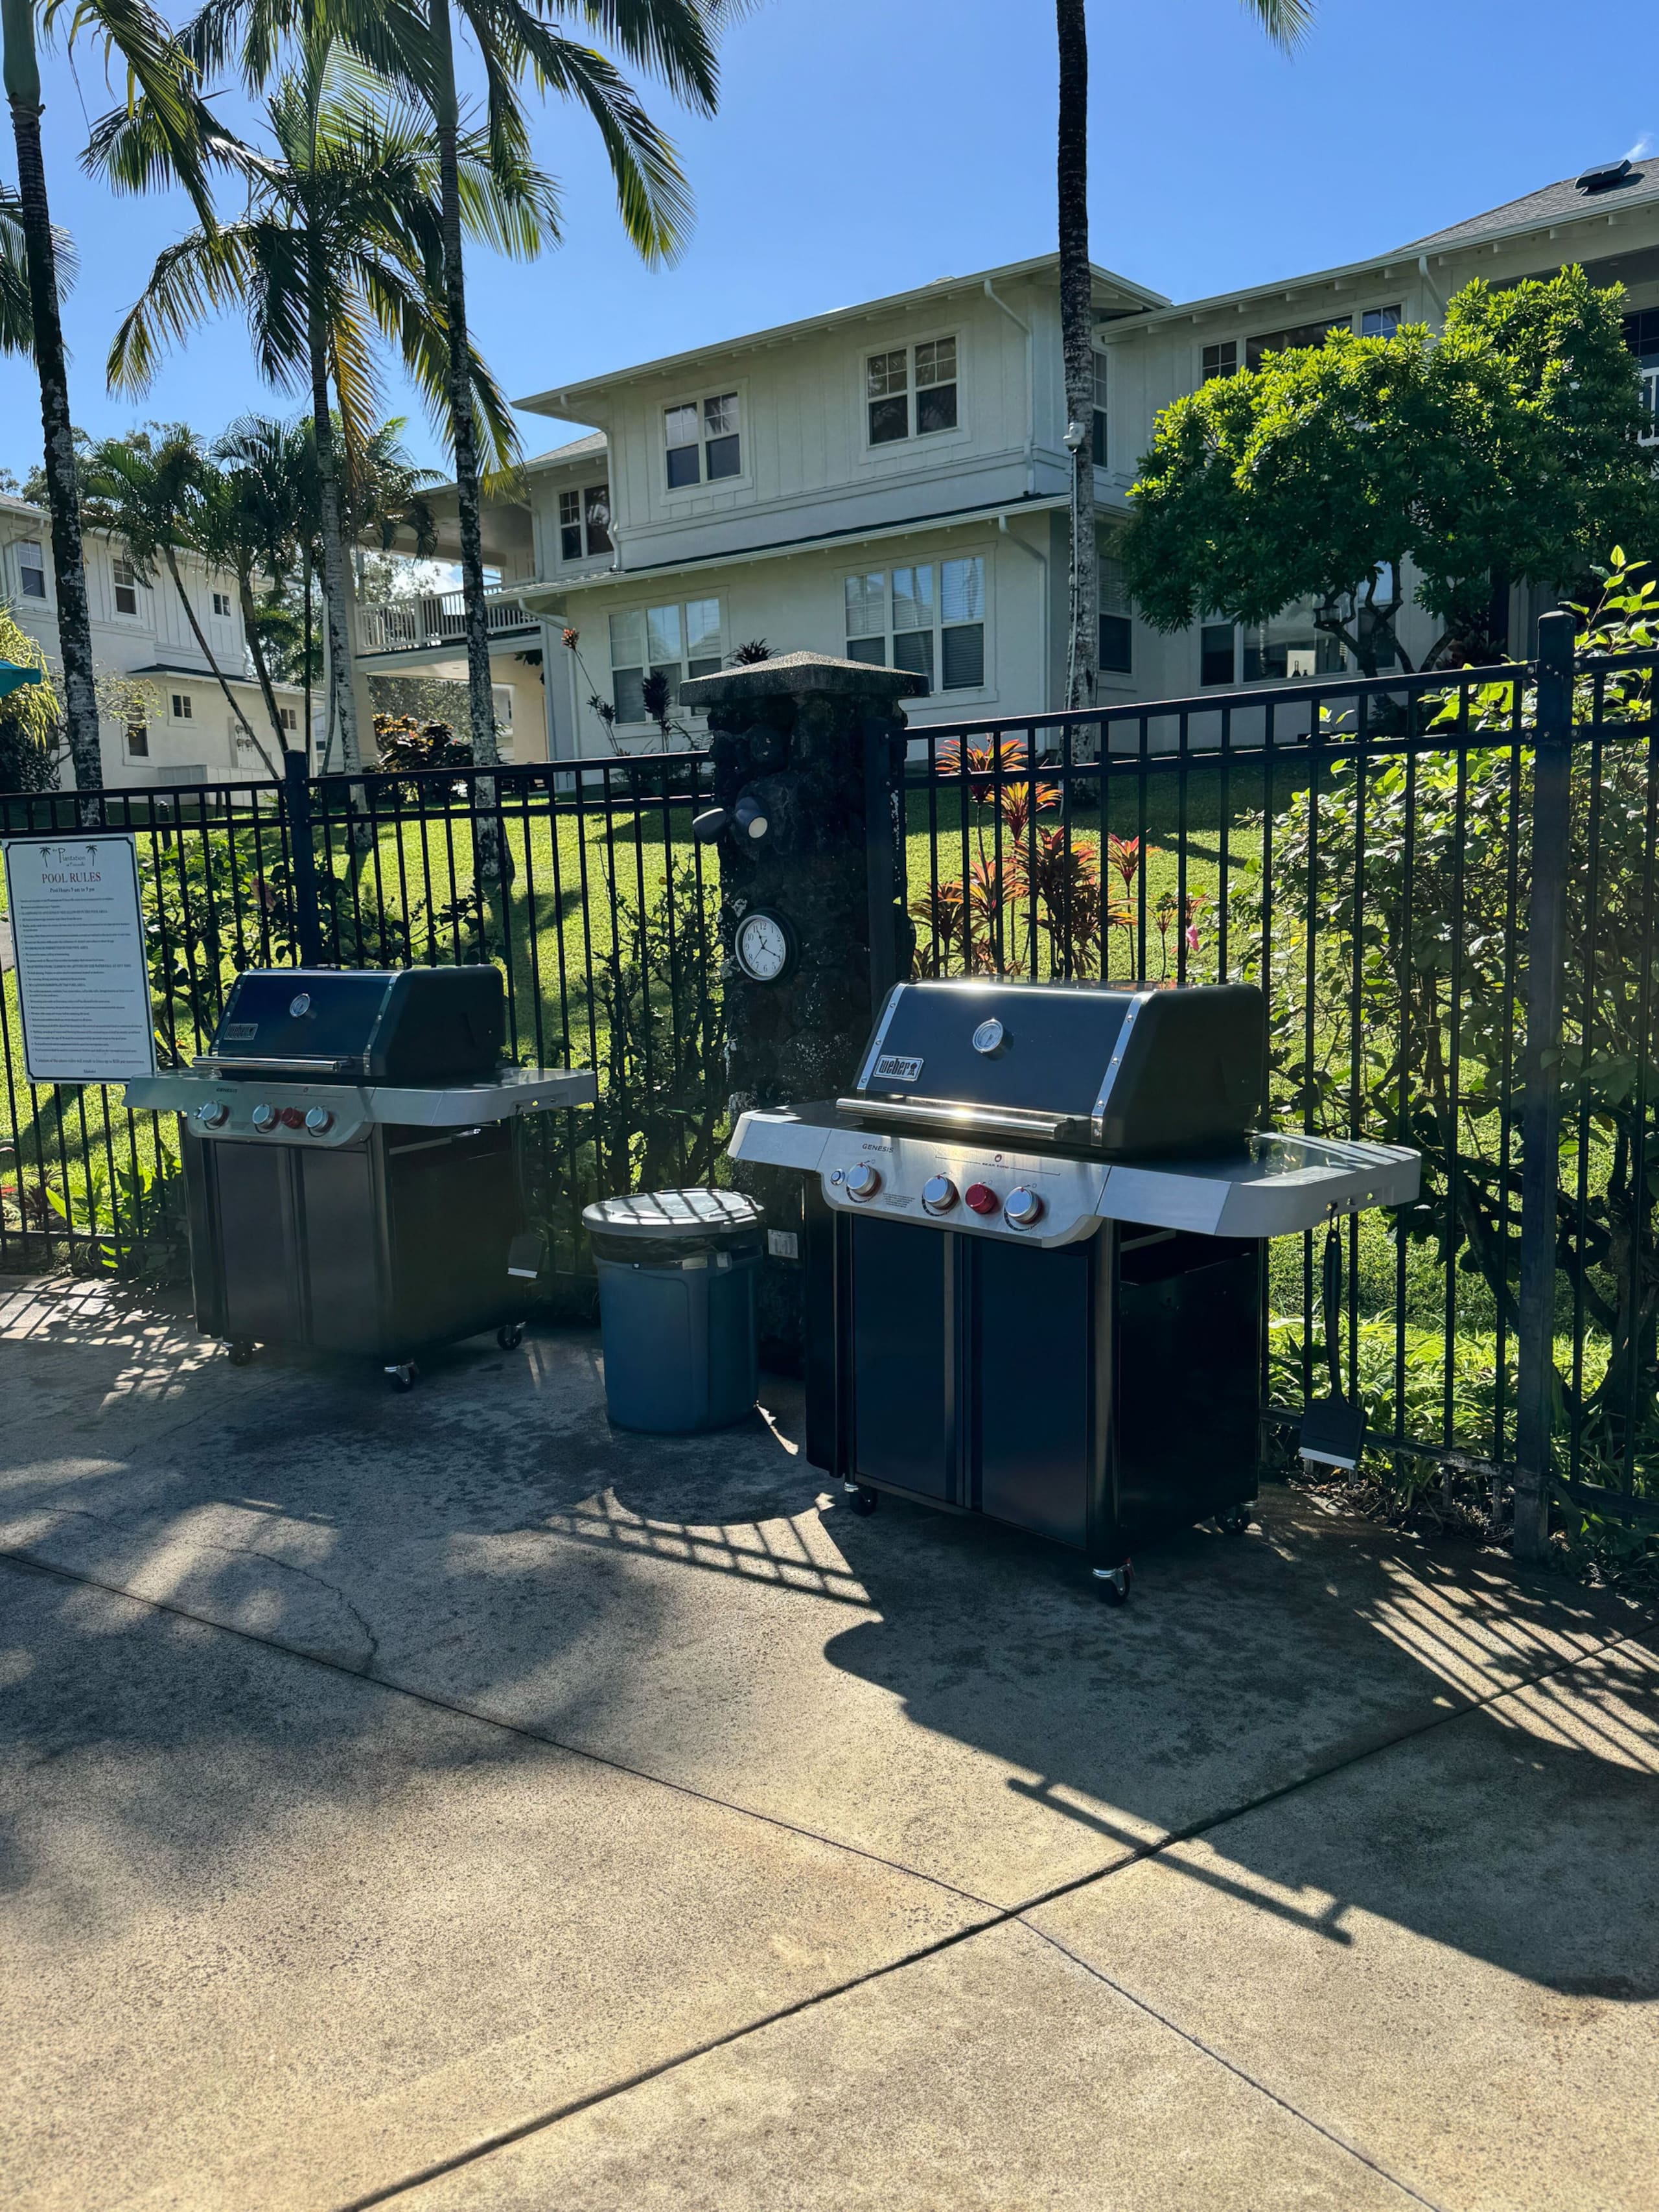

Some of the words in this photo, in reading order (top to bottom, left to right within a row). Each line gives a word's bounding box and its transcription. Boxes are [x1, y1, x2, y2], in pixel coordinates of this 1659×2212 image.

[42, 873, 67, 883] POOL
[69, 872, 101, 883] RULES
[756, 962, 760, 970] 7
[879, 1058, 910, 1075] weber
[863, 1143, 894, 1154] GENESIS
